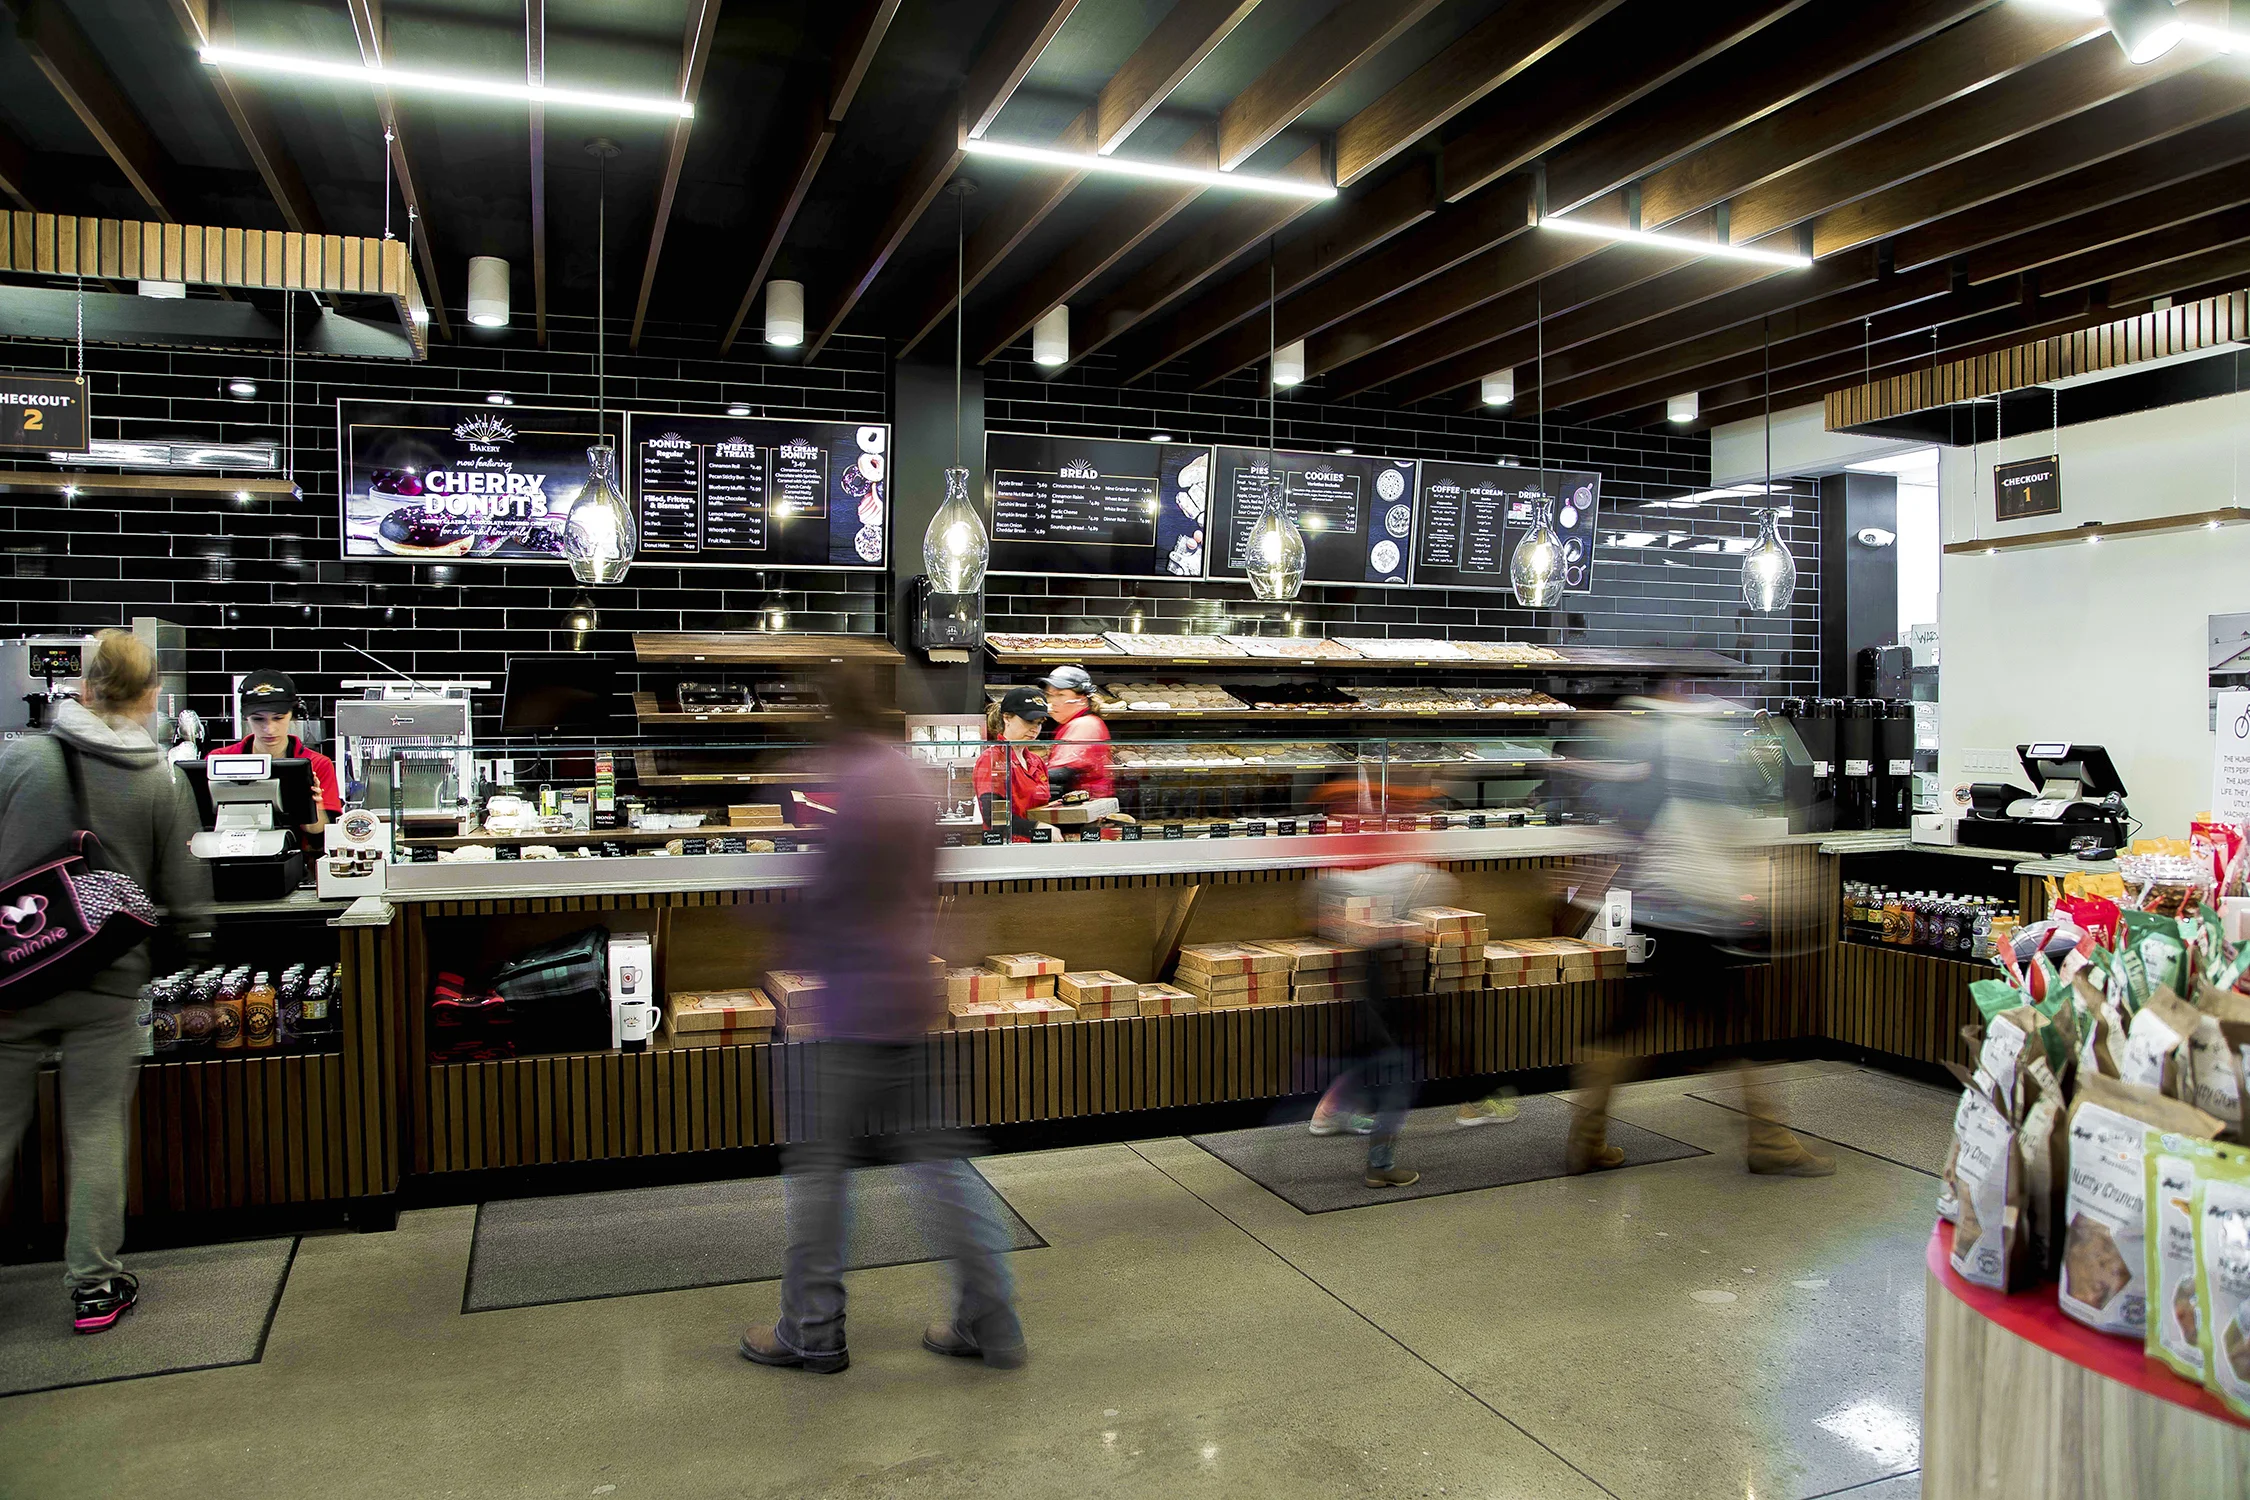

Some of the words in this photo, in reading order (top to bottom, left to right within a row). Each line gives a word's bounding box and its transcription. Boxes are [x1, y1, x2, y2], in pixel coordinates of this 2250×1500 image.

[24, 408, 43, 430] 2
[649, 439, 691, 449] DONUTS
[717, 443, 754, 451] SWEETS
[656, 450, 684, 459] Regular
[724, 450, 755, 458] TREATS
[780, 451, 818, 460] DONUTS
[474, 457, 512, 474] featuring
[1250, 466, 1269, 475] PIES
[1060, 468, 1098, 479] BREAD
[1305, 471, 1344, 482] COOKIES
[425, 471, 546, 493] CHERRY
[2003, 472, 2049, 487] CHECKOUT
[1431, 485, 1460, 494] COFFEE
[2023, 487, 2031, 502] 1
[643, 495, 666, 504] Filled,
[666, 496, 696, 504] Fritters,
[424, 493, 548, 518] DONUTS
[440, 525, 452, 536] for
[509, 527, 533, 543] only
[8, 926, 68, 964] minnie
